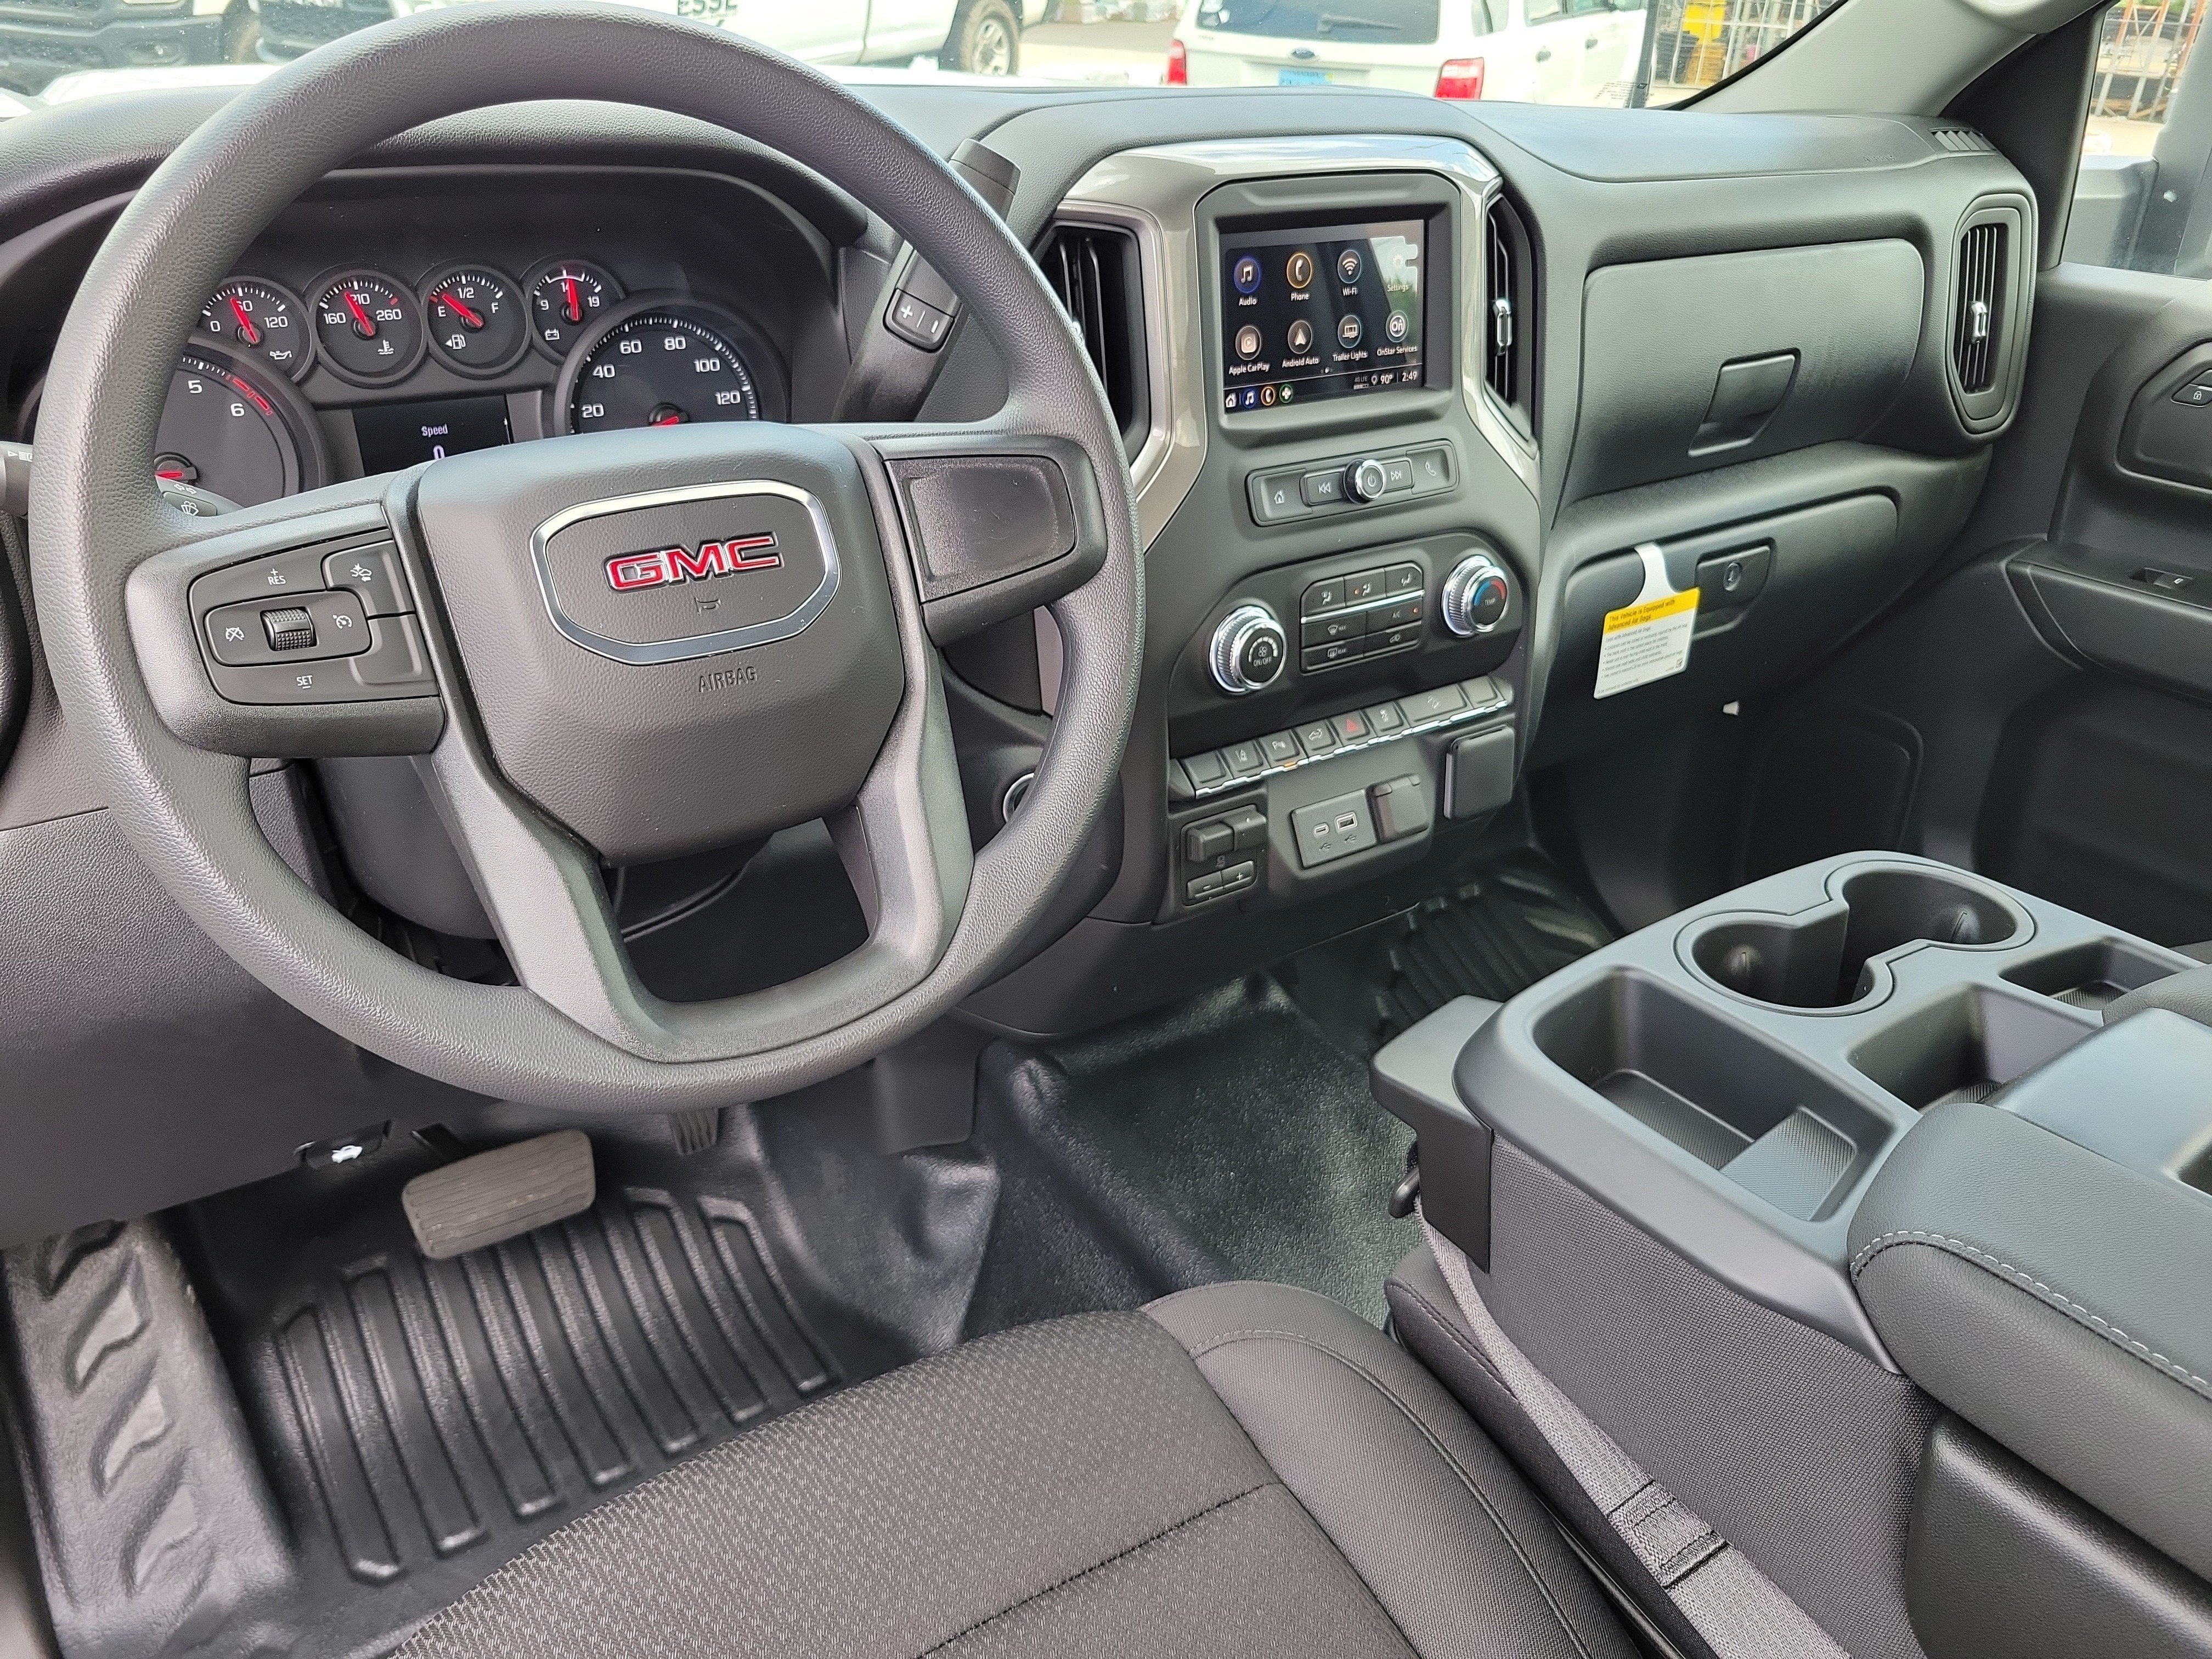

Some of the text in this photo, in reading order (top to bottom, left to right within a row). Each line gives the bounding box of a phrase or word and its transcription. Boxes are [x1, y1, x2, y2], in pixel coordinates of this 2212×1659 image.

[457, 287, 475, 300] 1/2
[1342, 286, 1358, 296] Wi-Fi
[1387, 284, 1409, 292] Settings
[588, 296, 600, 307] 19
[1239, 296, 1257, 306] Audio
[1291, 292, 1310, 301] Phone
[491, 302, 500, 314] F
[540, 299, 549, 311] 9
[376, 308, 402, 321] 260
[438, 306, 447, 318] E
[264, 316, 288, 328] 120
[323, 312, 346, 325] 160
[210, 320, 221, 332] 0
[619, 340, 642, 354] 60
[664, 336, 686, 351] 80
[1333, 350, 1368, 362] Trailer Lights
[1376, 346, 1418, 357] OnStar Services
[695, 358, 721, 373] 100
[1282, 357, 1320, 368] Android Auto
[593, 364, 616, 379] 40
[1228, 362, 1270, 376] Apple CarPlay
[1402, 371, 1418, 382] 2:49
[188, 380, 202, 394] 5
[716, 390, 741, 406] 120
[230, 403, 245, 417] 6
[582, 404, 605, 419] 20
[421, 423, 449, 438] Speed
[606, 535, 781, 591] GMC
[268, 574, 286, 585] RES
[1607, 619, 1632, 631] Advanced
[1253, 657, 1272, 667] ON/OFF
[296, 675, 313, 686] SET
[698, 665, 758, 693] AIRBAG
